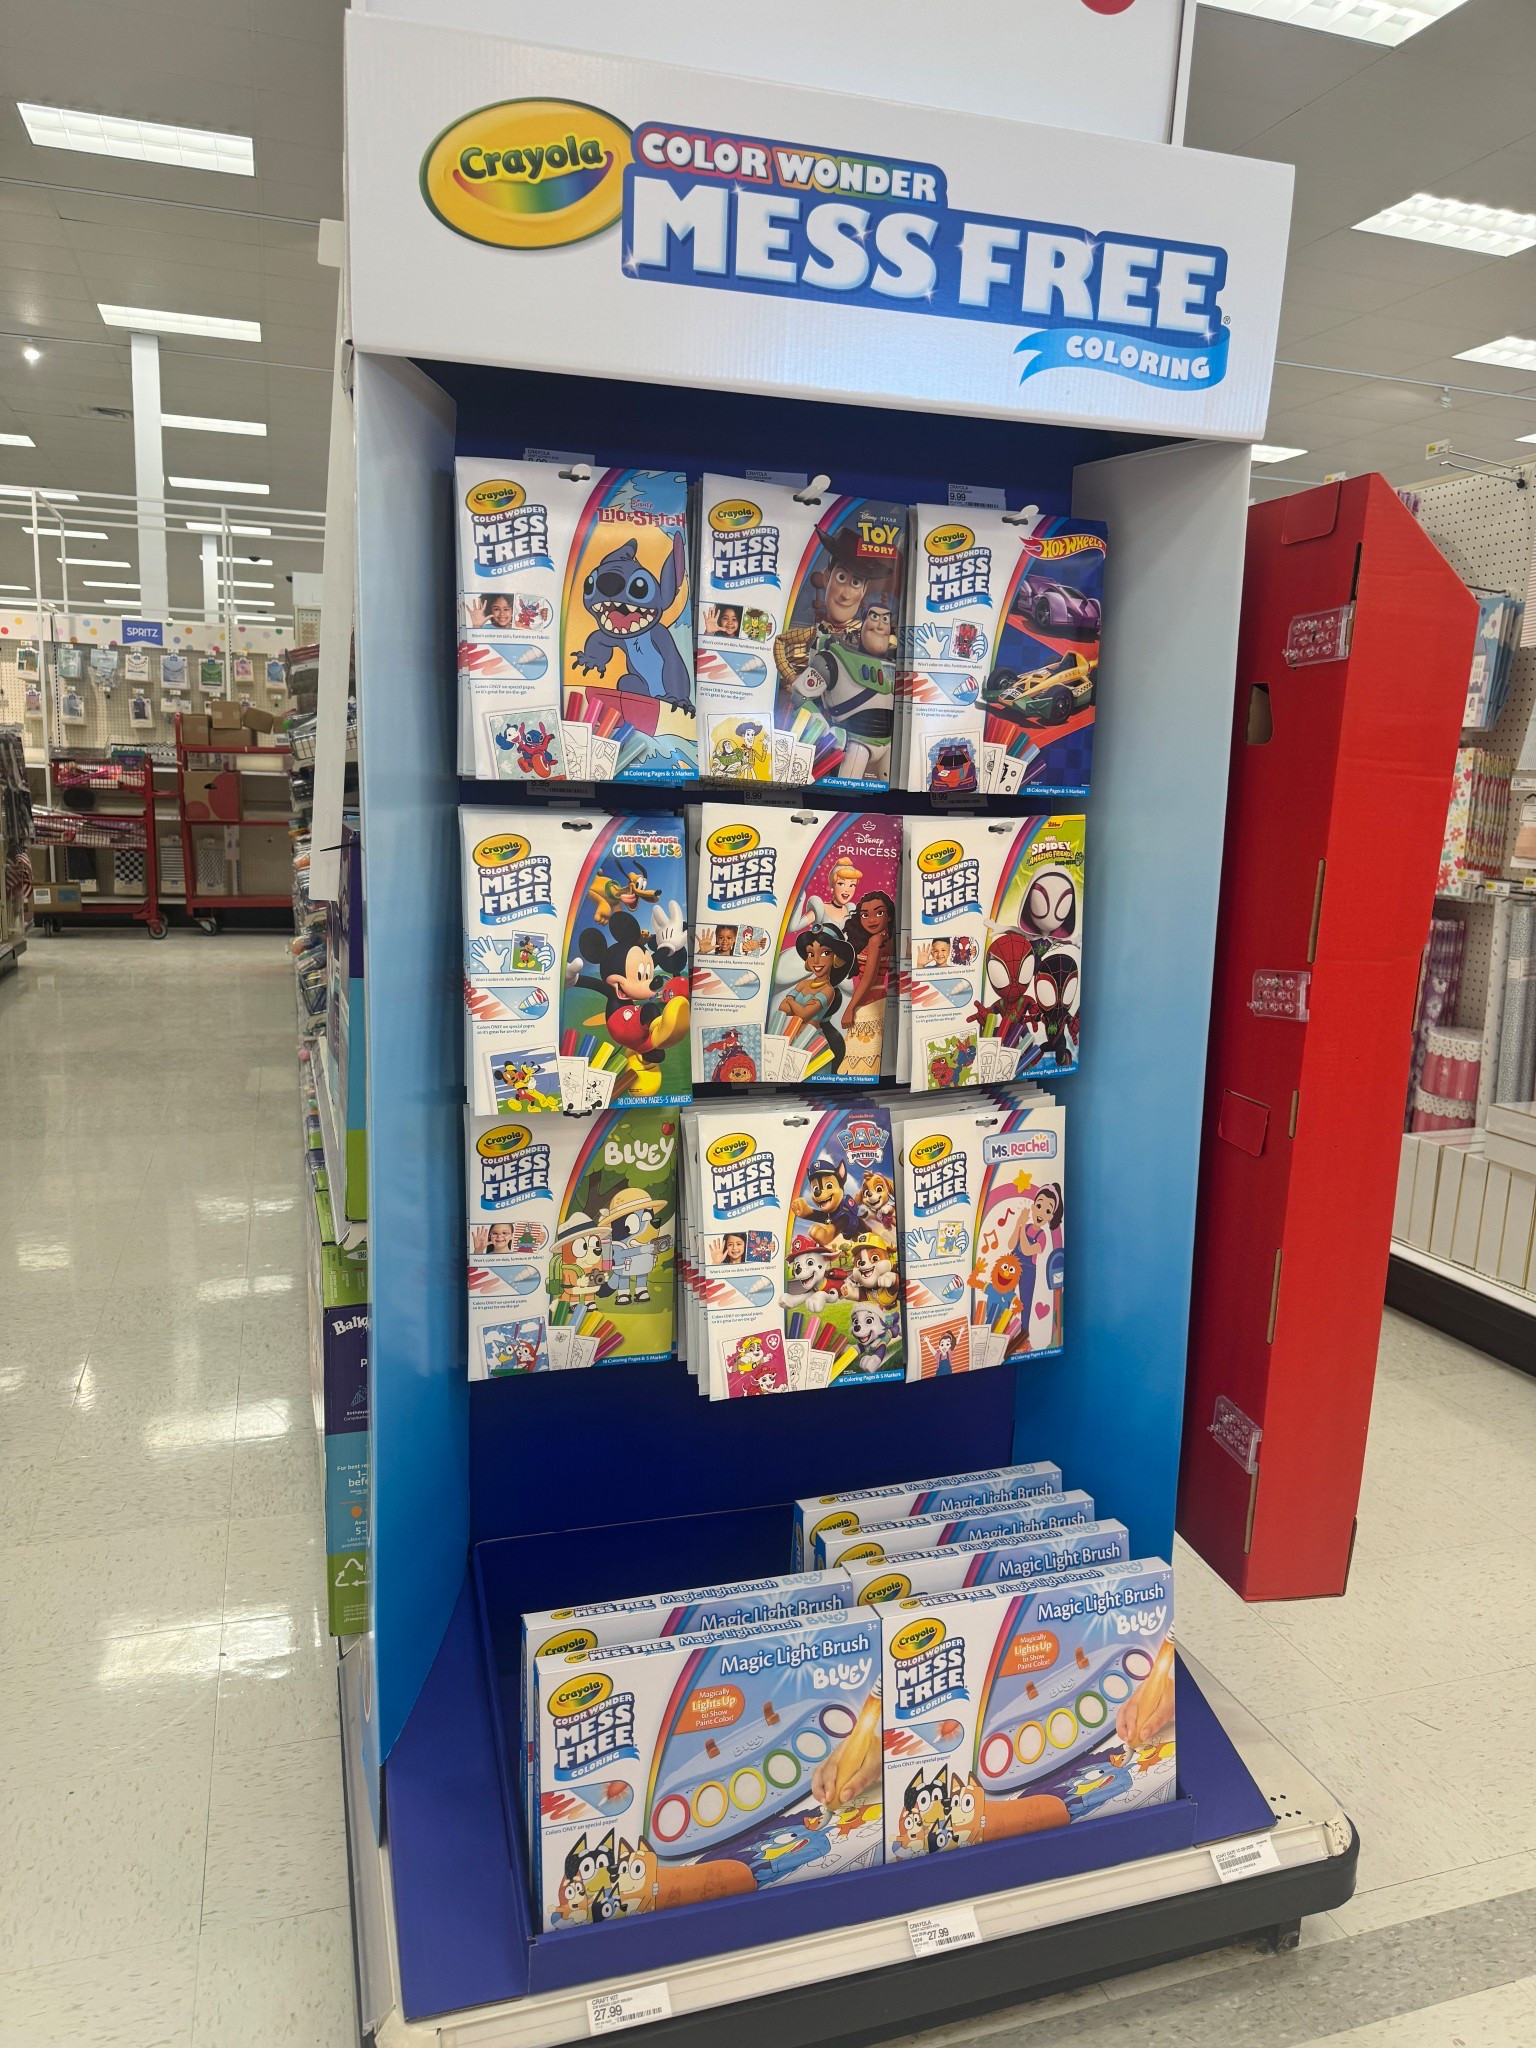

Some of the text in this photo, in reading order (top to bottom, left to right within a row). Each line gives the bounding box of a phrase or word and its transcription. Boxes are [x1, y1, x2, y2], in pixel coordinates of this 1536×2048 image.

[459, 135, 604, 180] Crayola
[642, 132, 938, 203] COLOR WONDER
[632, 175, 1217, 334] MESS FREE
[1066, 334, 1210, 381] COLORING
[475, 488, 514, 501] Crayola
[950, 492, 966, 501] 9.99
[473, 506, 545, 523] COLOR WONDER
[717, 508, 752, 519] Crayola
[860, 511, 877, 522] Disney
[475, 515, 545, 544] MESS
[713, 527, 777, 540] COLOR WONDER
[857, 522, 900, 545] TOY
[933, 532, 965, 544] Crayola
[478, 535, 547, 566] FREE
[713, 536, 776, 558] MESS
[861, 543, 894, 555] STORY
[929, 549, 990, 564] COLOR WONDER
[491, 559, 536, 576] COLORING
[715, 554, 776, 579] FREE
[929, 557, 989, 582] MESS
[724, 576, 765, 588] COLORING
[930, 575, 989, 602] FREE
[940, 597, 978, 611] COLORING
[126, 627, 159, 638] SPRITZ
[617, 836, 678, 844] MICKEY MOUSE
[716, 832, 750, 843] Crayola
[854, 832, 884, 847] Disney
[482, 841, 519, 854] Crayola
[613, 843, 682, 858] CLUBHOUSE
[712, 849, 775, 864] COLOR WONDER
[838, 845, 897, 858] PRINCESS
[925, 847, 954, 861] Crayola
[1031, 841, 1071, 856] SPIDEY
[480, 857, 549, 875] COLOR WONDER
[711, 857, 774, 882] MESS
[922, 860, 978, 880] COLOR WONDER
[481, 866, 549, 894] MESS
[712, 875, 773, 901] FREE
[923, 868, 977, 898] MESS
[484, 884, 550, 914] FREE
[721, 895, 762, 909] COLORING
[925, 885, 977, 915] FREE
[495, 907, 539, 924] COLORING
[934, 905, 969, 923] COLORING
[624, 1097, 647, 1105] COLORING
[648, 1096, 663, 1104] PAGES
[670, 1095, 692, 1103] MARKERS
[486, 1132, 521, 1145] Crayola
[714, 1140, 747, 1154] Crayola
[836, 1128, 890, 1151] PAW
[482, 1145, 548, 1164] COLOR WONDER
[851, 1151, 879, 1160] PATROL
[916, 1141, 943, 1156] Crayola
[1010, 1139, 1050, 1157] Rachel
[483, 1153, 547, 1182] MESS
[712, 1153, 773, 1174] COLOR WONDER
[914, 1153, 965, 1174] COLOR WONDER
[485, 1170, 548, 1200] FREE
[714, 1161, 773, 1192] MESS
[915, 1161, 965, 1192] MESS
[495, 1191, 536, 1209] COLORING
[716, 1178, 774, 1210] FREE
[917, 1178, 966, 1208] FREE
[726, 1199, 765, 1218] COLORING
[925, 1197, 958, 1215] COLORING
[999, 1544, 1120, 1577] Magic Light Brush
[1162, 1573, 1171, 1581] 3+
[1037, 1583, 1164, 1621] Magic Light Brush
[867, 1623, 878, 1631] 3+
[899, 1626, 936, 1646] Crayola
[1020, 1633, 1047, 1645] Magically
[720, 1634, 869, 1674] Magic Light Brush
[896, 1638, 963, 1668] COLOR WONDER
[1014, 1641, 1052, 1657] Lights Up
[1029, 1653, 1046, 1662] Show
[897, 1648, 963, 1689] MESS
[1017, 1659, 1050, 1671] Paint Color!
[558, 1681, 600, 1702] Crayola
[700, 1687, 730, 1699] Magically
[899, 1668, 964, 1709] FREE
[555, 1694, 632, 1726] COLOR WONDER
[692, 1696, 736, 1712] Lights Up
[910, 1692, 953, 1717] COLORING
[696, 1715, 734, 1727] Paint Color!
[710, 1709, 728, 1718] Show
[556, 1704, 632, 1748] MESS
[559, 1725, 633, 1769] FREE
[571, 1751, 620, 1778] COLORING
[585, 1821, 602, 1829] special
[909, 1920, 931, 1929] CRAYOLA
[927, 1927, 949, 1940] 27.99
[592, 1994, 618, 2006] CRAFT KIT
[593, 2004, 623, 2021] 27.99
